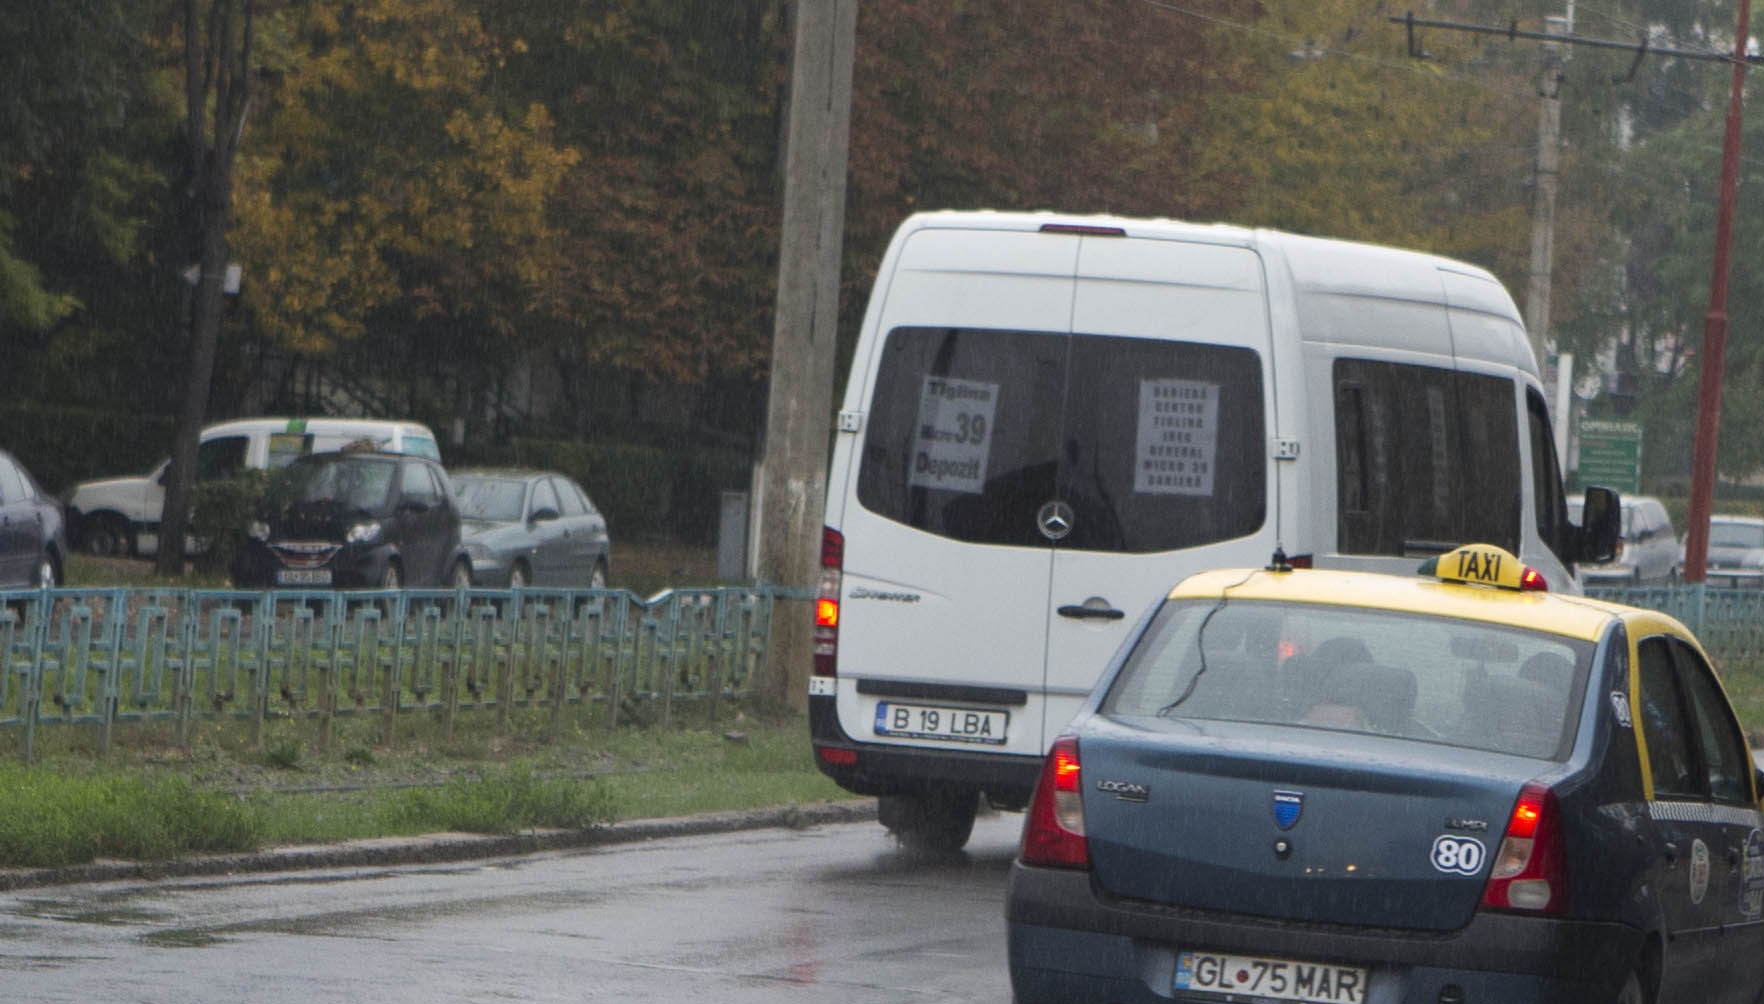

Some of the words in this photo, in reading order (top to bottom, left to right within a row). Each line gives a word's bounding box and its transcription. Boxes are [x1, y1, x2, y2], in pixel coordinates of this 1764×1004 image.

[956, 412, 986, 446] 39
[916, 451, 980, 481] Depozit
[1457, 549, 1502, 582] TAXI
[893, 708, 911, 729] B
[919, 710, 941, 732] 19
[950, 712, 992, 735] LBA
[1096, 779, 1149, 796] LOGAN
[1437, 839, 1480, 871] 80
[1194, 956, 1234, 990] GL
[1250, 961, 1288, 993] 75
[1294, 965, 1359, 1001] MAR
